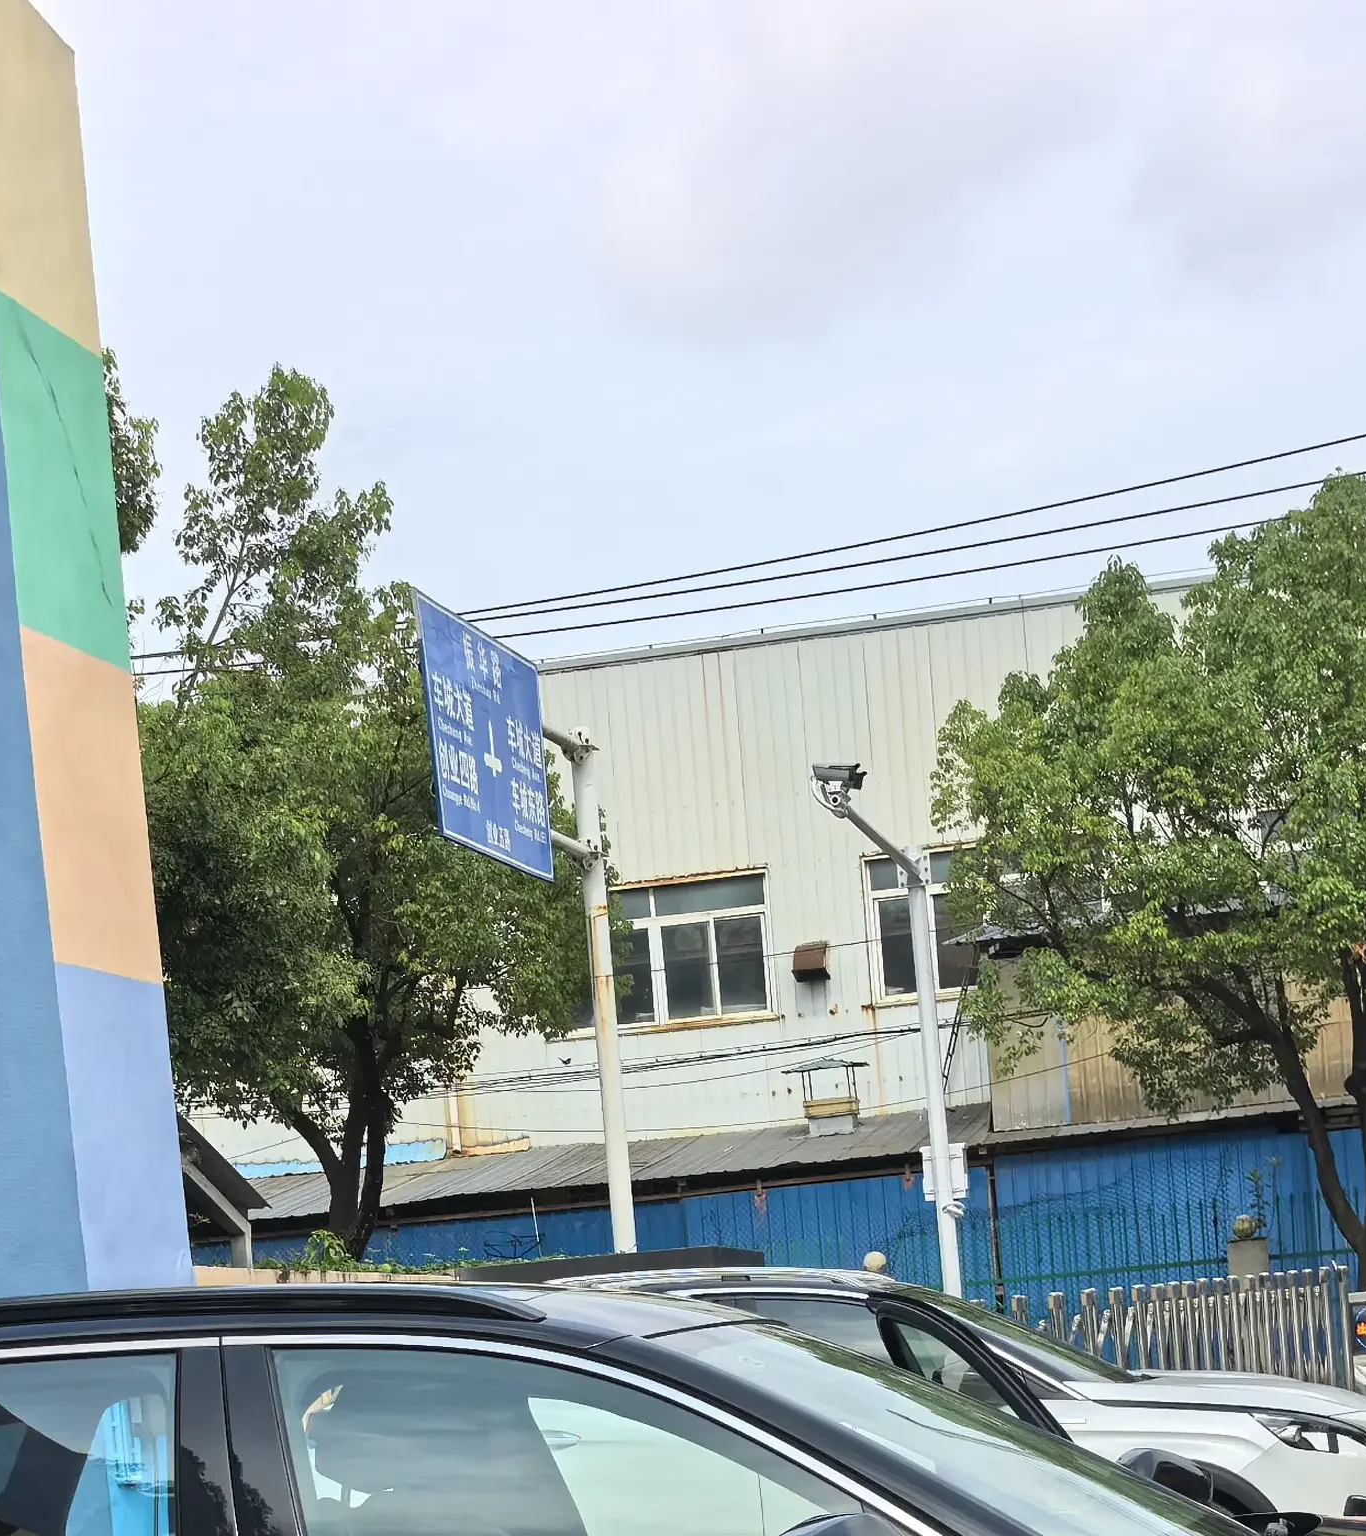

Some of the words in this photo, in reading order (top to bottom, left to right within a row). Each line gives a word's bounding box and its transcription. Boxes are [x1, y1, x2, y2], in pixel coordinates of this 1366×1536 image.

[431, 671, 475, 732] 车城大道
[438, 737, 480, 796] 创业四路
[506, 715, 543, 770] 车城大道
[510, 777, 546, 828] 车城东路
